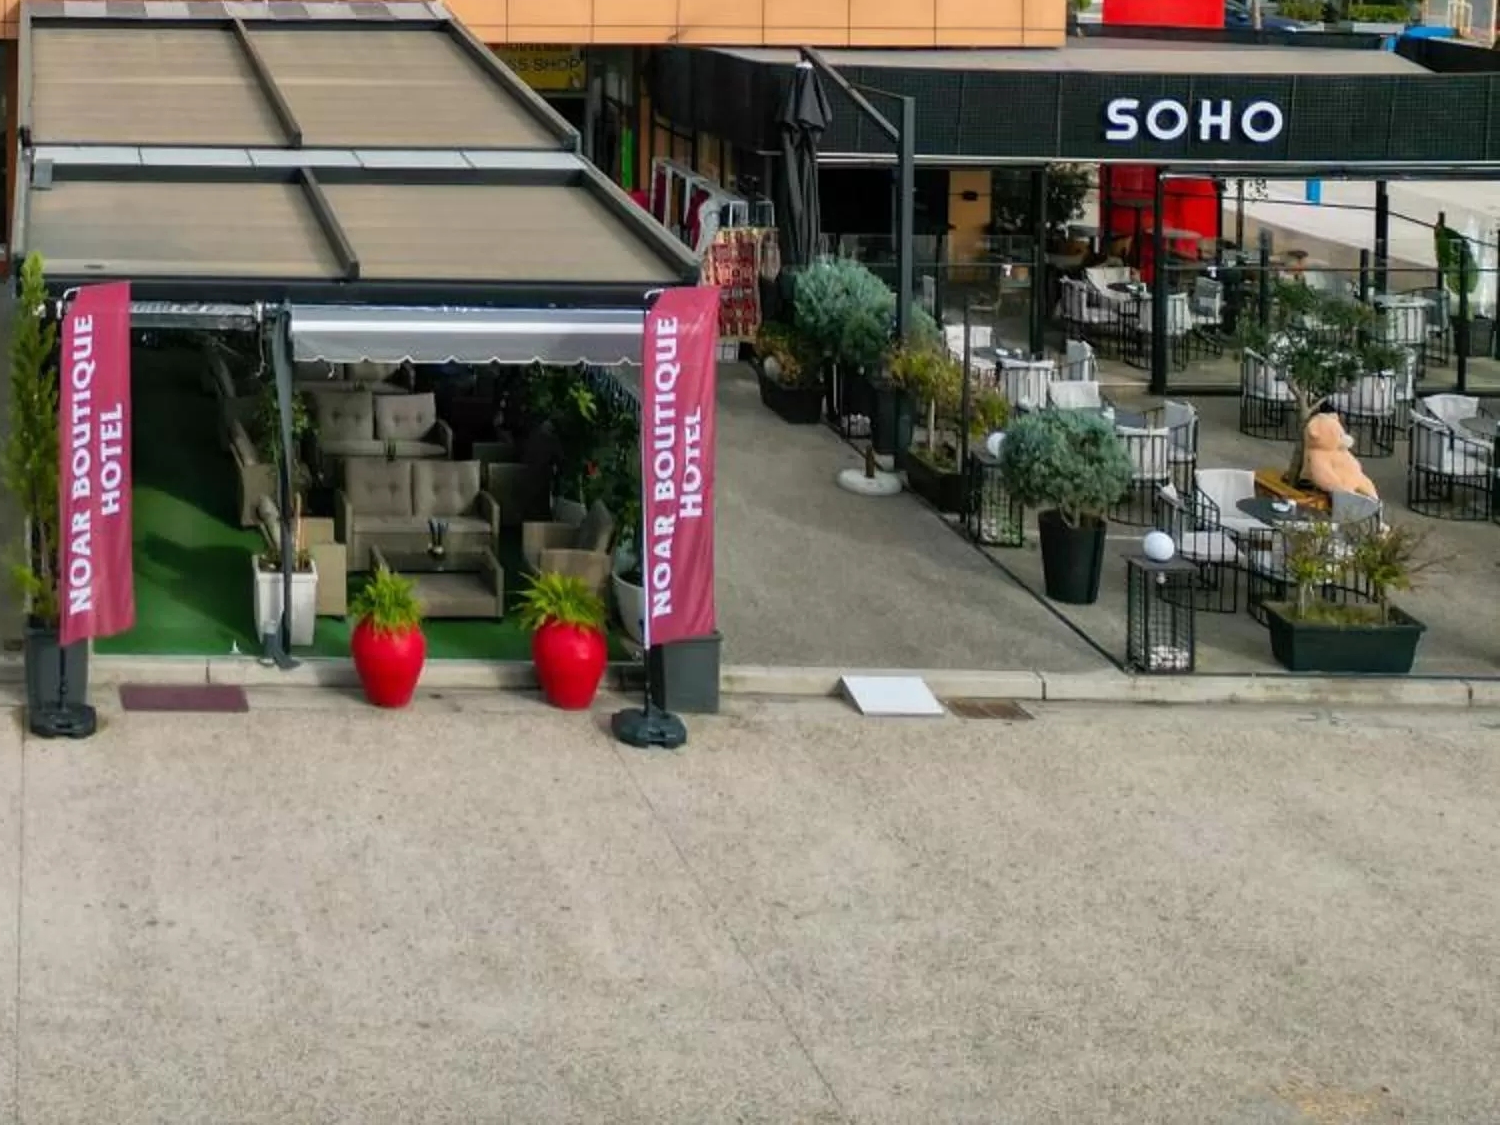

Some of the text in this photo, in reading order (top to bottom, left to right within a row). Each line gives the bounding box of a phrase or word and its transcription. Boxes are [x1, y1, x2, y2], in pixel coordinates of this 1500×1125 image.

[1105, 98, 1283, 142] SOHO
[69, 314, 96, 615] NOAR BOUTIQUE
[101, 402, 123, 515] HOTEL
[651, 315, 681, 618] NOAR BOUTIQUE
[680, 404, 703, 519] HOTEL
